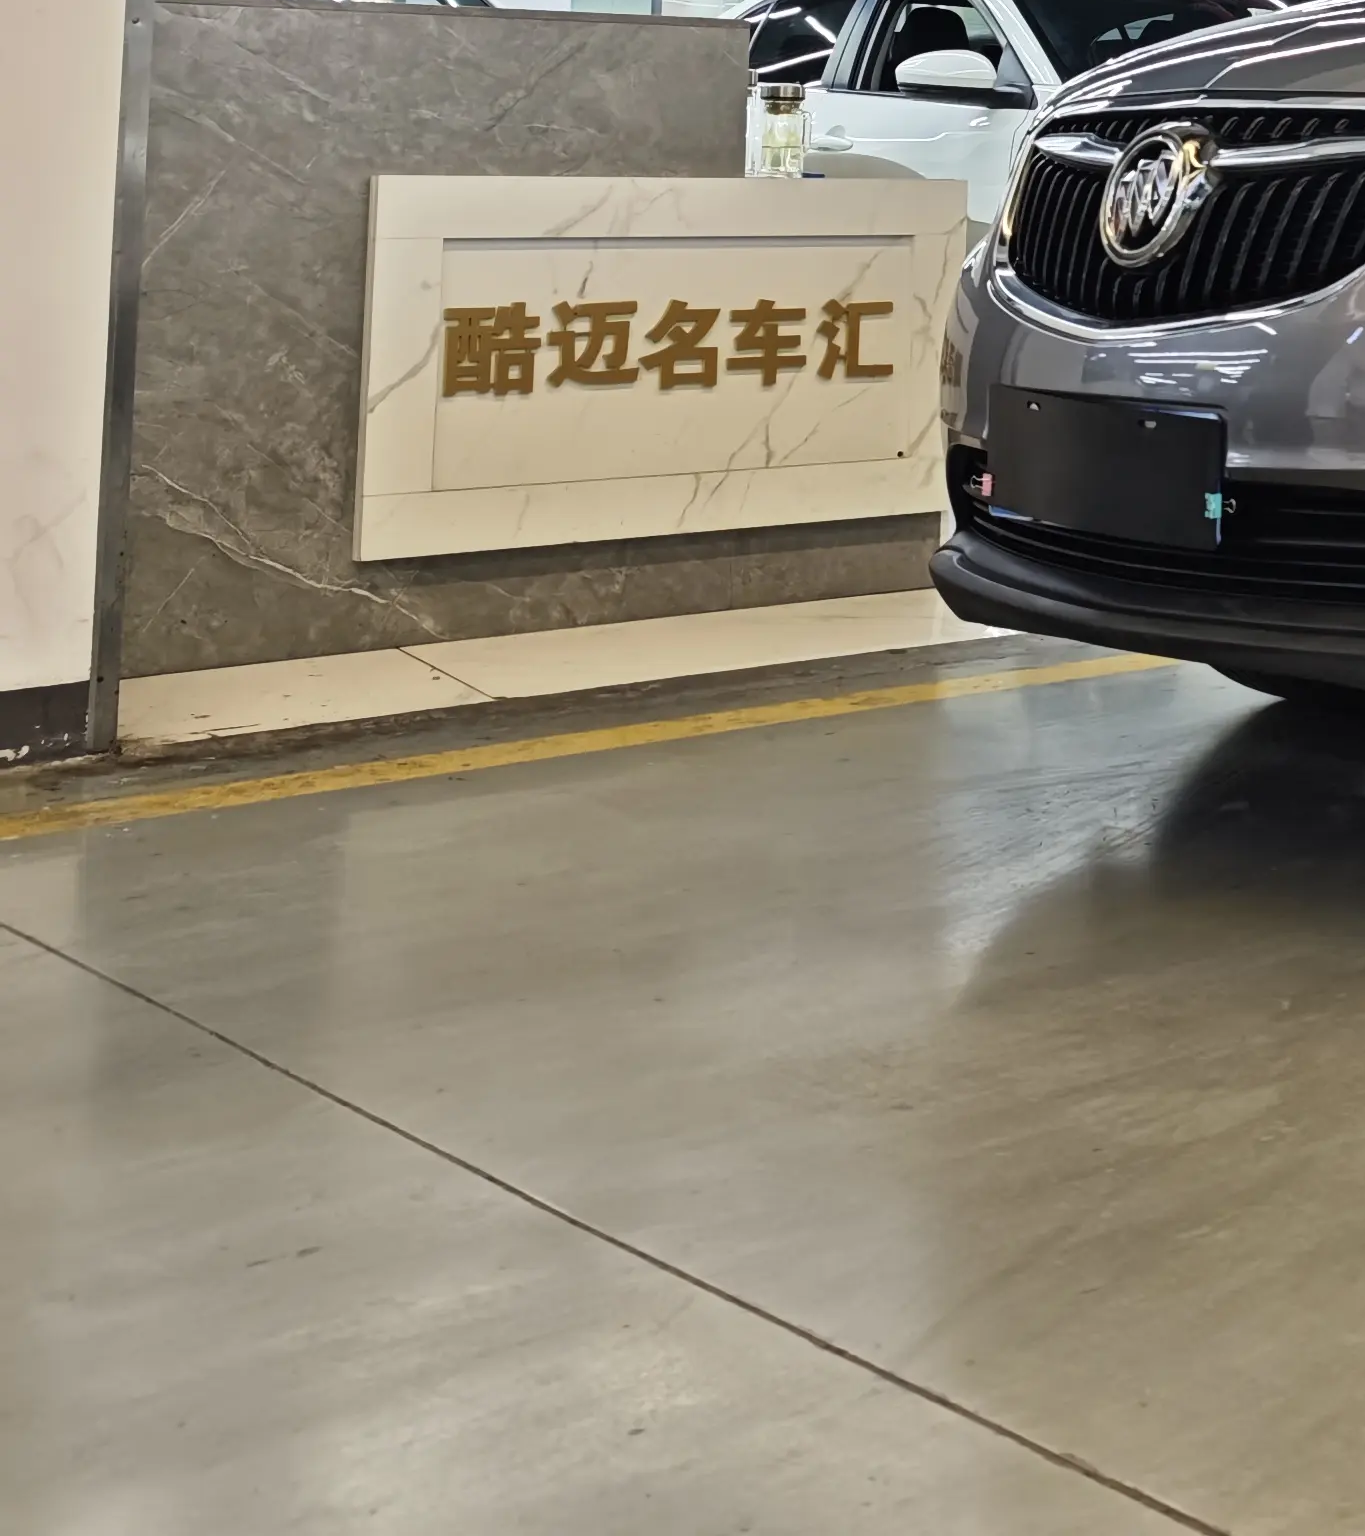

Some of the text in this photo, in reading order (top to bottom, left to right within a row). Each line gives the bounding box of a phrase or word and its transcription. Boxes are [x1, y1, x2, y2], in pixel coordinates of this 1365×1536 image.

[441, 297, 895, 398] 酷迈名车汇
